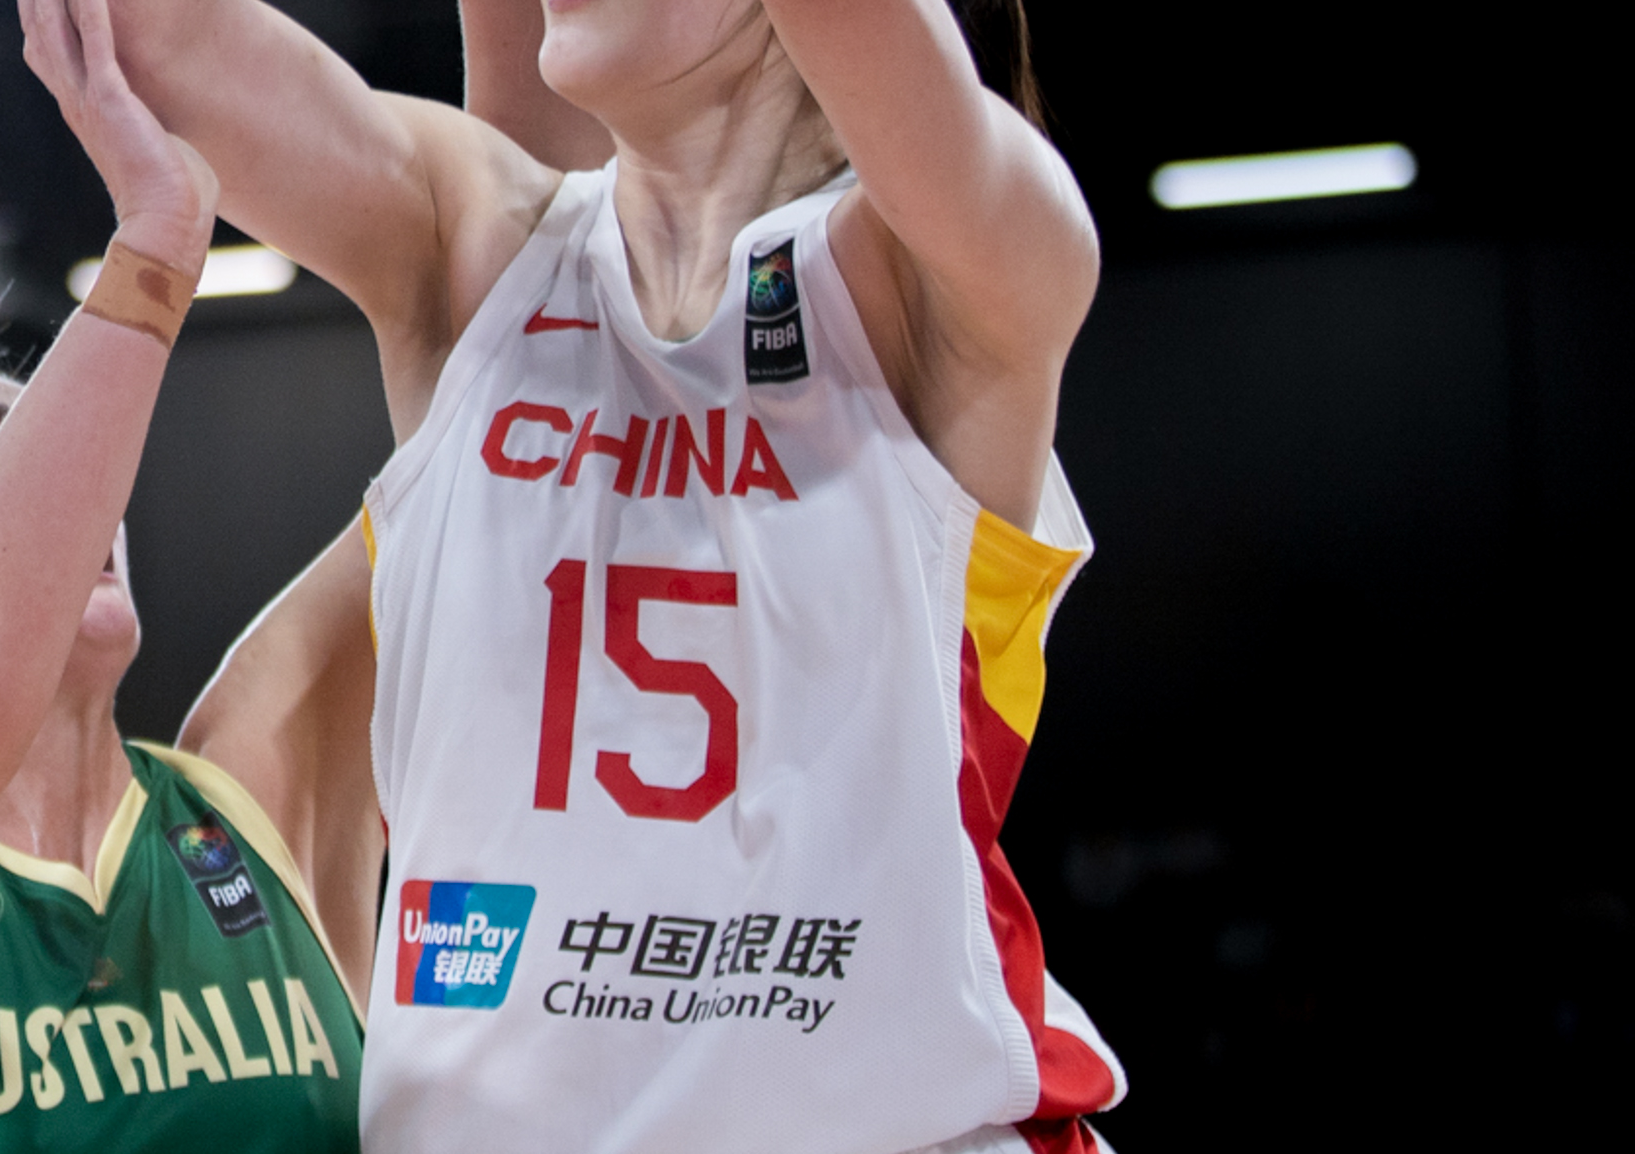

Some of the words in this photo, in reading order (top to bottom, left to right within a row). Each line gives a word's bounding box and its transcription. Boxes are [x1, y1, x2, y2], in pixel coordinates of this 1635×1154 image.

[752, 322, 798, 351] FIBA
[480, 399, 800, 502] CHINA
[533, 557, 738, 822] 15
[208, 874, 253, 908] FIBA
[402, 909, 520, 962] UnionPay
[557, 911, 862, 980] 中国银联
[433, 949, 504, 986] 银联
[542, 980, 654, 1021] China
[662, 984, 836, 1034] UnionPay
